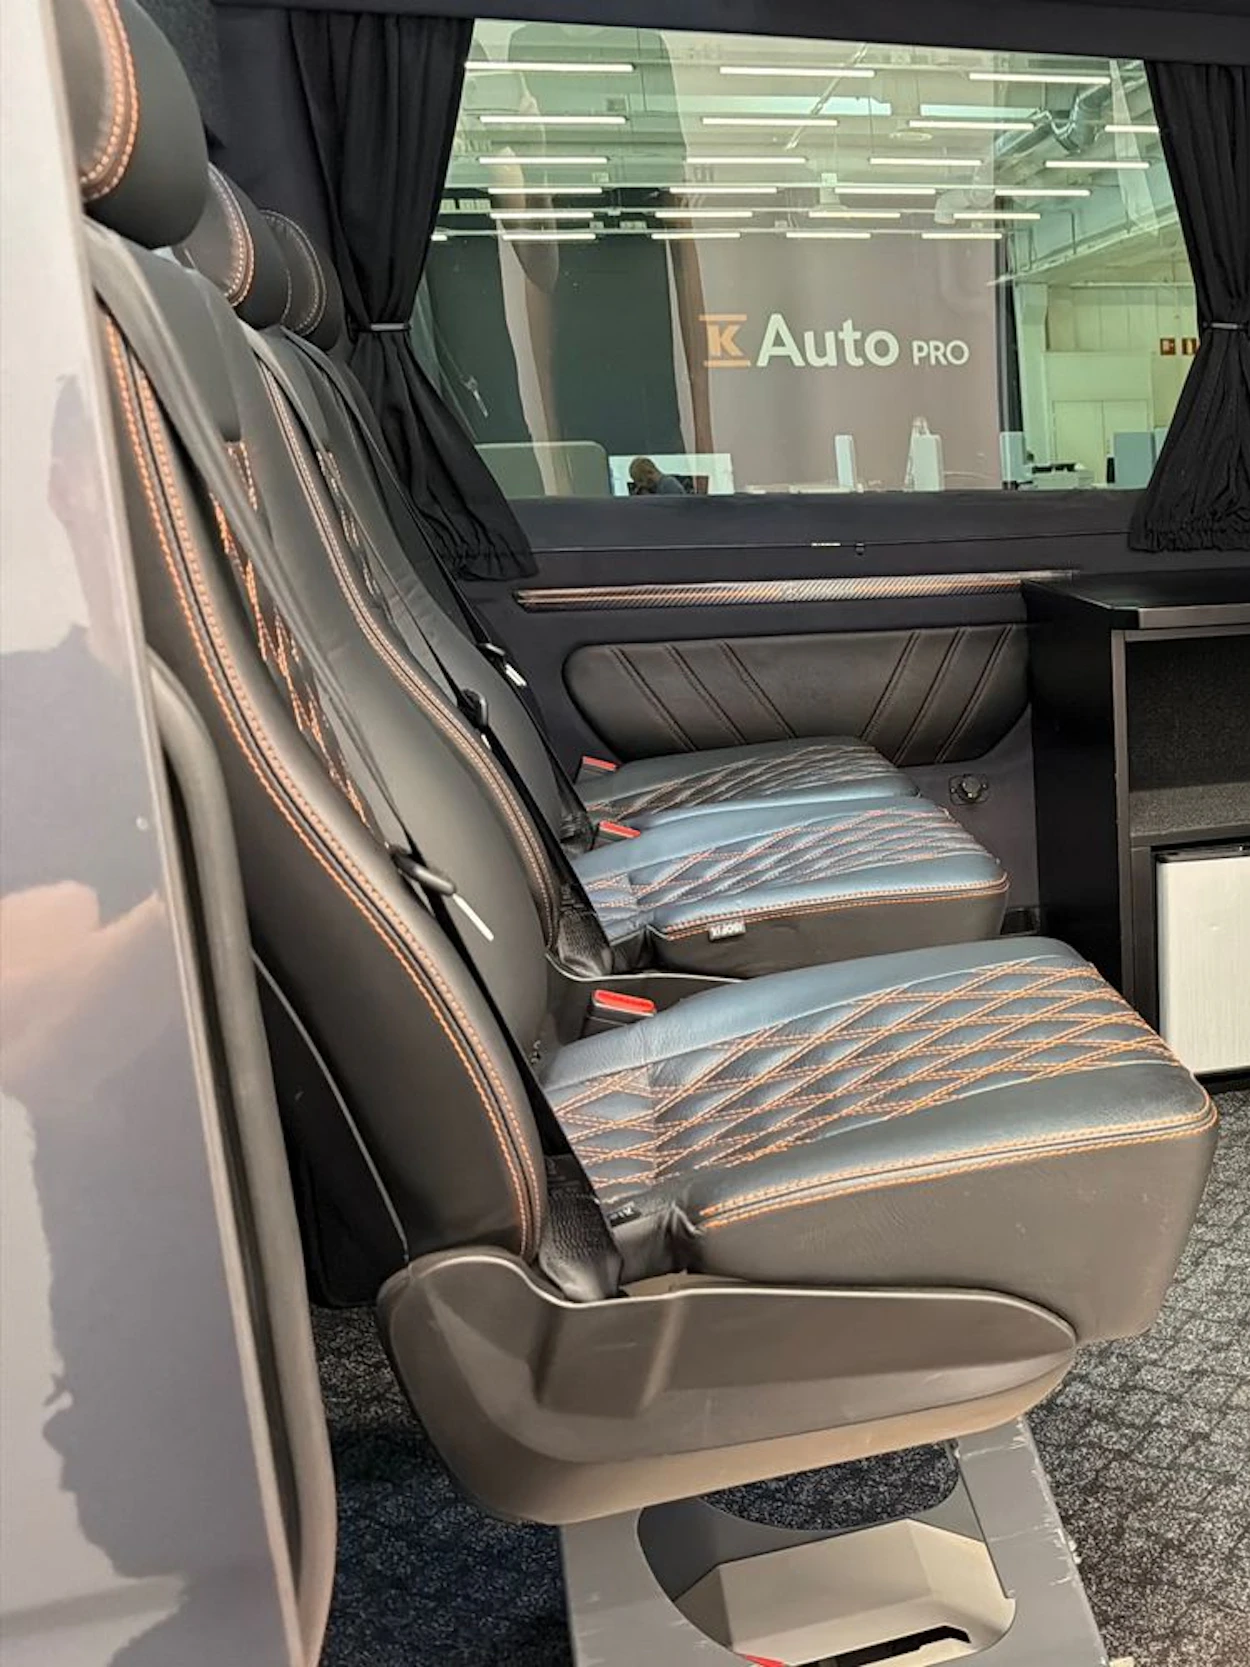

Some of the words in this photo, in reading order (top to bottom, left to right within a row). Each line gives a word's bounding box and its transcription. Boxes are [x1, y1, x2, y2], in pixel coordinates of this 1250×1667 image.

[702, 316, 748, 364] K
[756, 313, 900, 367] Auto
[912, 340, 970, 366] PRO
